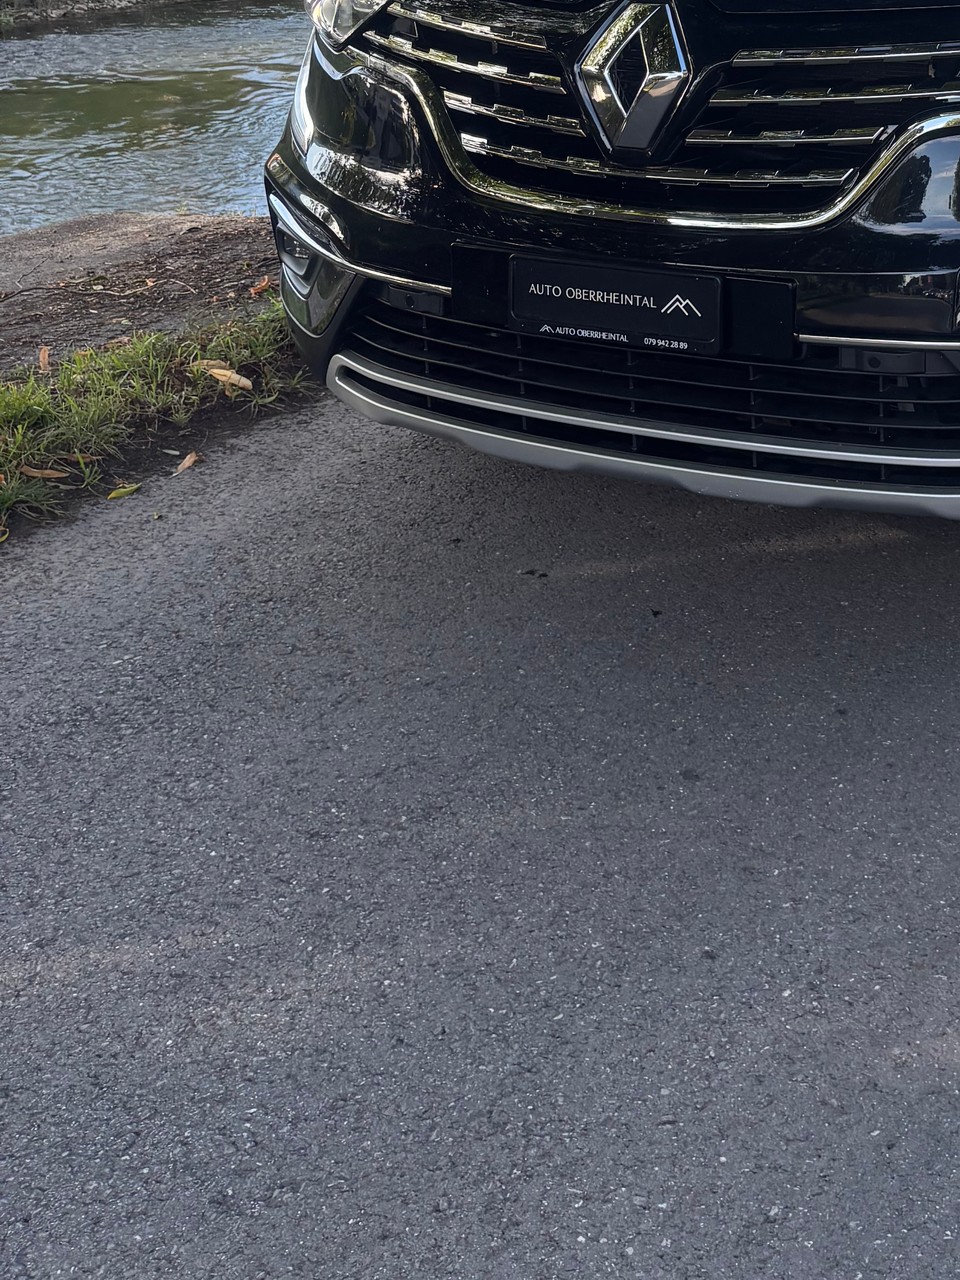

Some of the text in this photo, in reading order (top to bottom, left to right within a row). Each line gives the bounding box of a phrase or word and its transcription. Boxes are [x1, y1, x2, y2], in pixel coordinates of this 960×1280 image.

[529, 283, 657, 308] AUTO OBERRHEINTAL
[555, 326, 629, 343] AUTO OBERRHEINTAL
[644, 337, 688, 350] 079 942 28 89
